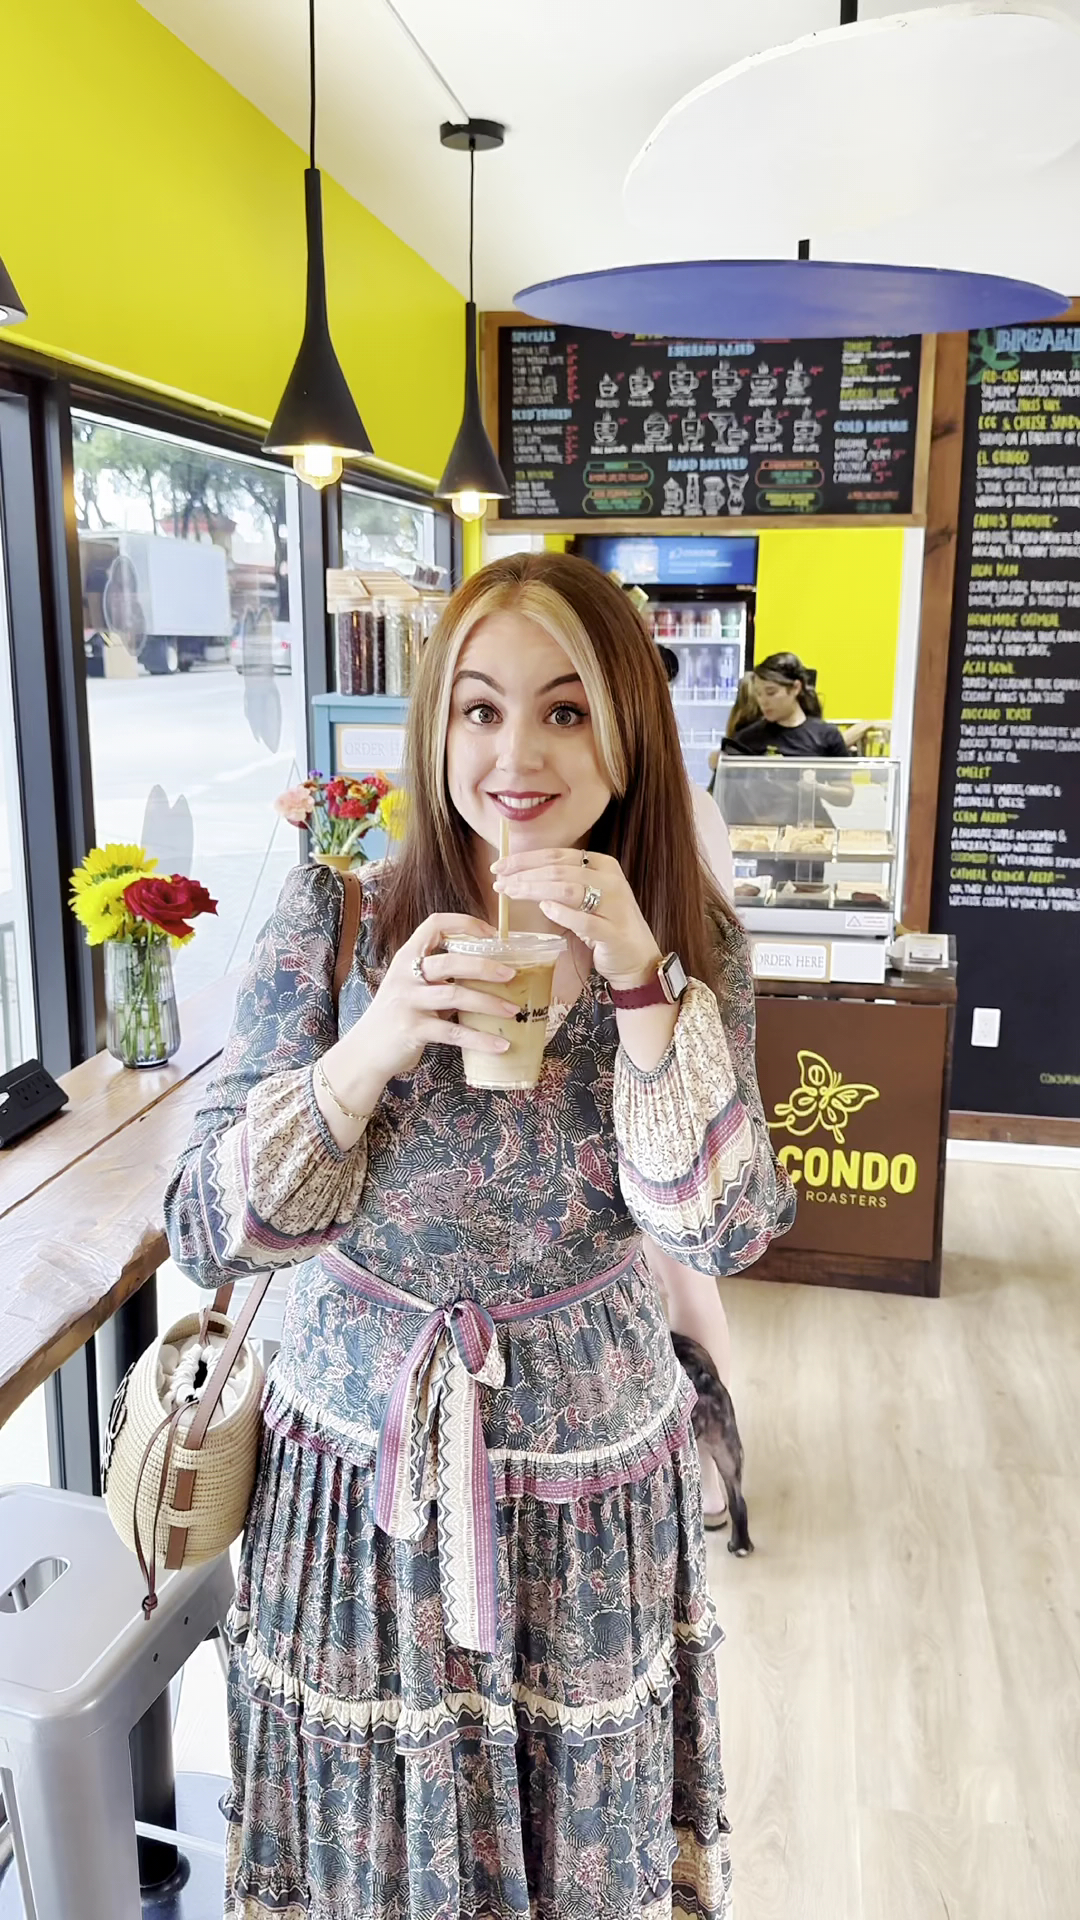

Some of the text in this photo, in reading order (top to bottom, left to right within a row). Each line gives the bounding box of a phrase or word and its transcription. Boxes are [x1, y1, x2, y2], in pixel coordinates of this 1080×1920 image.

[796, 955, 823, 968] HERE
[778, 1145, 916, 1194] CONDO
[806, 1191, 887, 1208] ROASTERS
